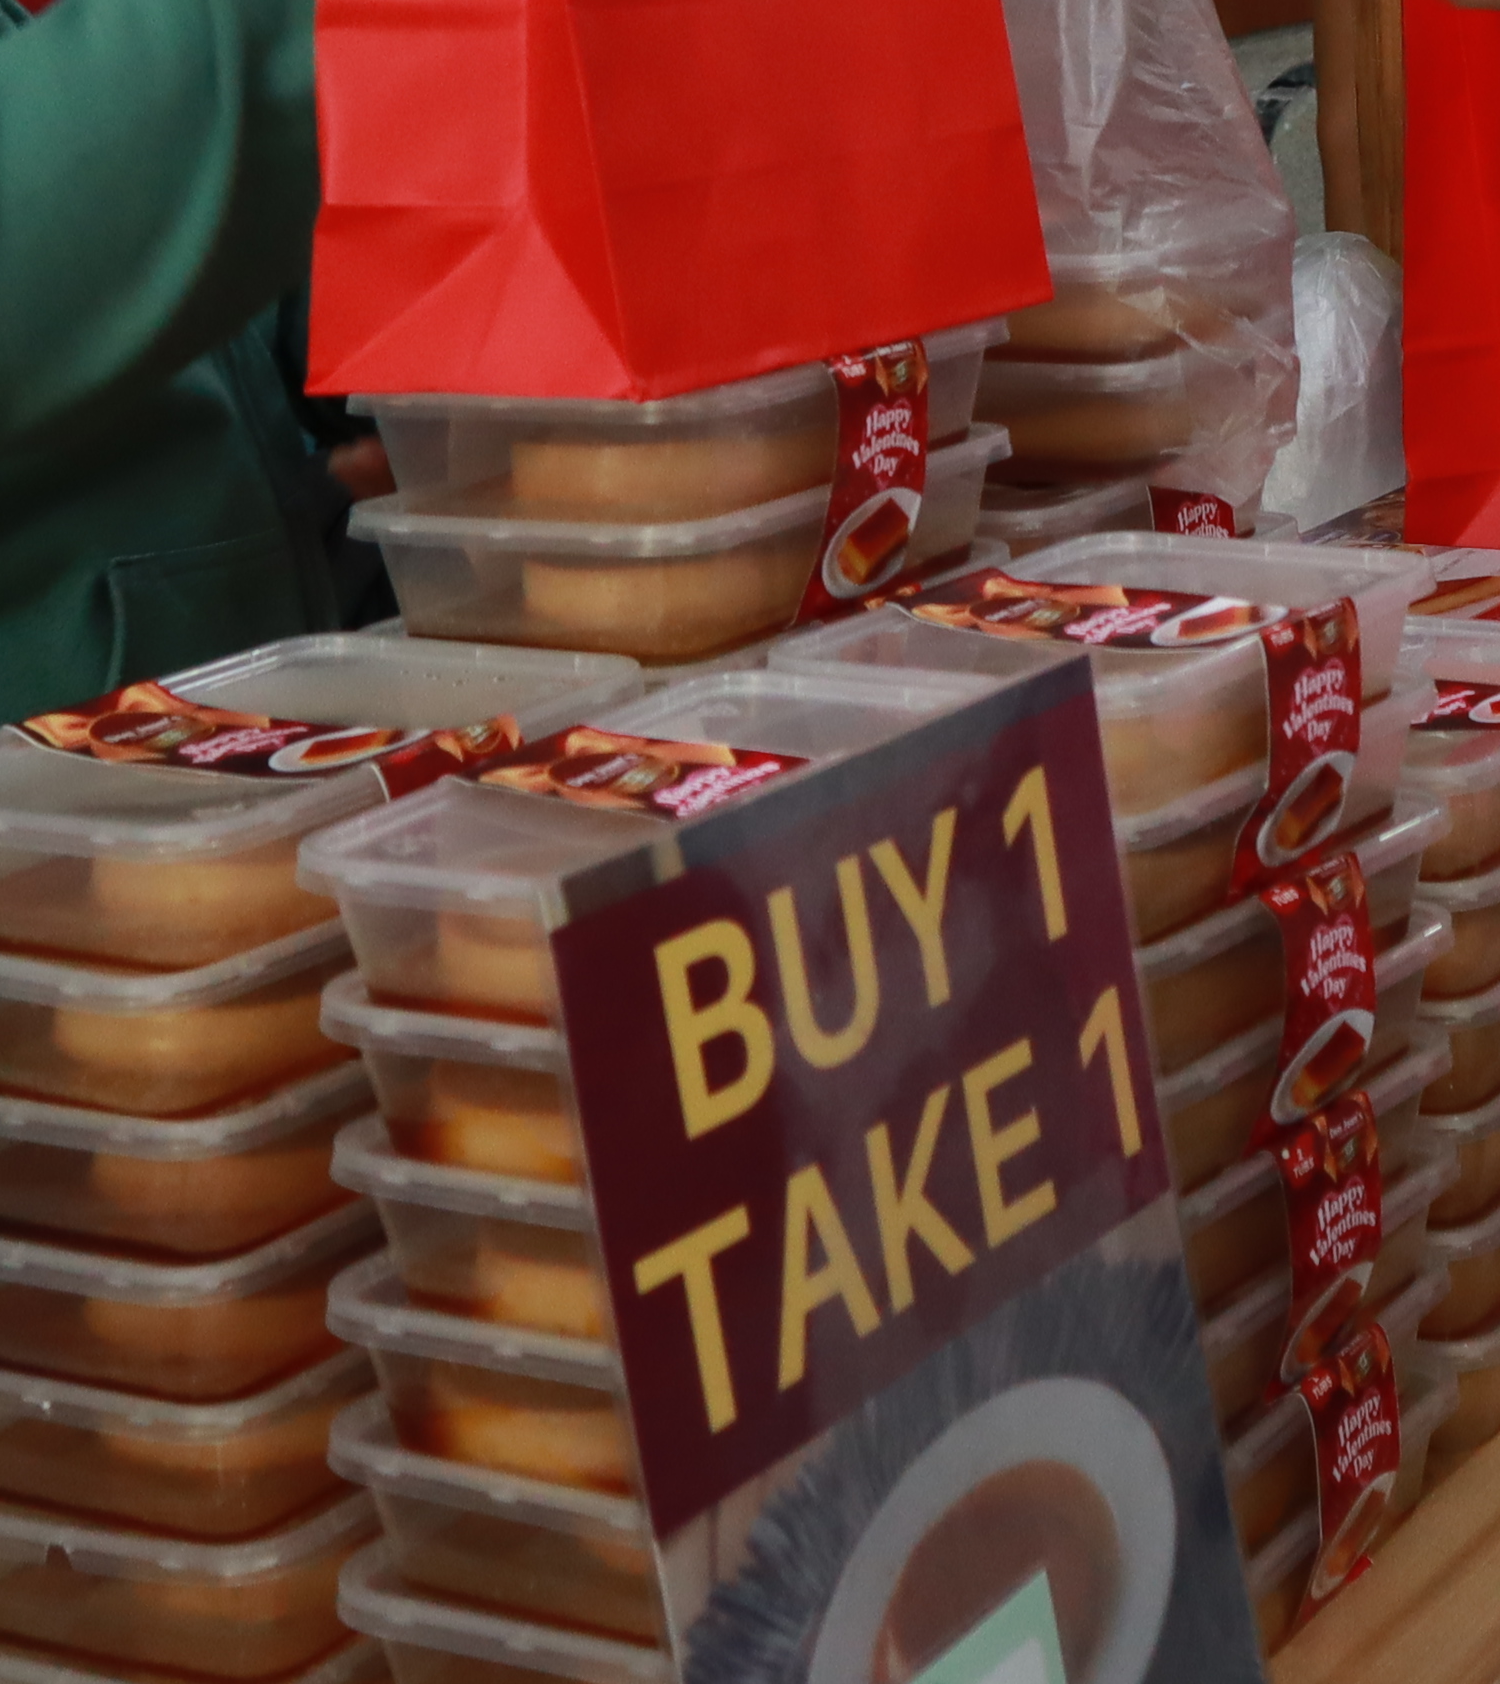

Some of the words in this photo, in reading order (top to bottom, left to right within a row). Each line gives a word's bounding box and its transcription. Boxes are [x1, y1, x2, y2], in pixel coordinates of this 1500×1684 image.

[866, 406, 913, 438] Happy
[852, 431, 921, 470] Valentines
[873, 454, 899, 478] Day
[1177, 503, 1218, 532] Happy
[1293, 669, 1346, 706] Happy
[1282, 694, 1355, 740] Valentines
[1307, 718, 1333, 743] Day
[653, 805, 958, 1142] BUY
[1000, 763, 1070, 944] 1
[1310, 924, 1355, 962] Happy
[1300, 948, 1367, 998] Valentines
[1322, 976, 1347, 1000] Day
[632, 1036, 1060, 1434] TAKE
[1077, 982, 1145, 1161] 1
[1317, 1184, 1366, 1232] Happy
[1309, 1210, 1377, 1267] Valentines
[1332, 1237, 1358, 1265] Day
[1337, 1394, 1382, 1448] Happy
[1332, 1418, 1393, 1484] Valentines
[1353, 1448, 1375, 1479] Day
